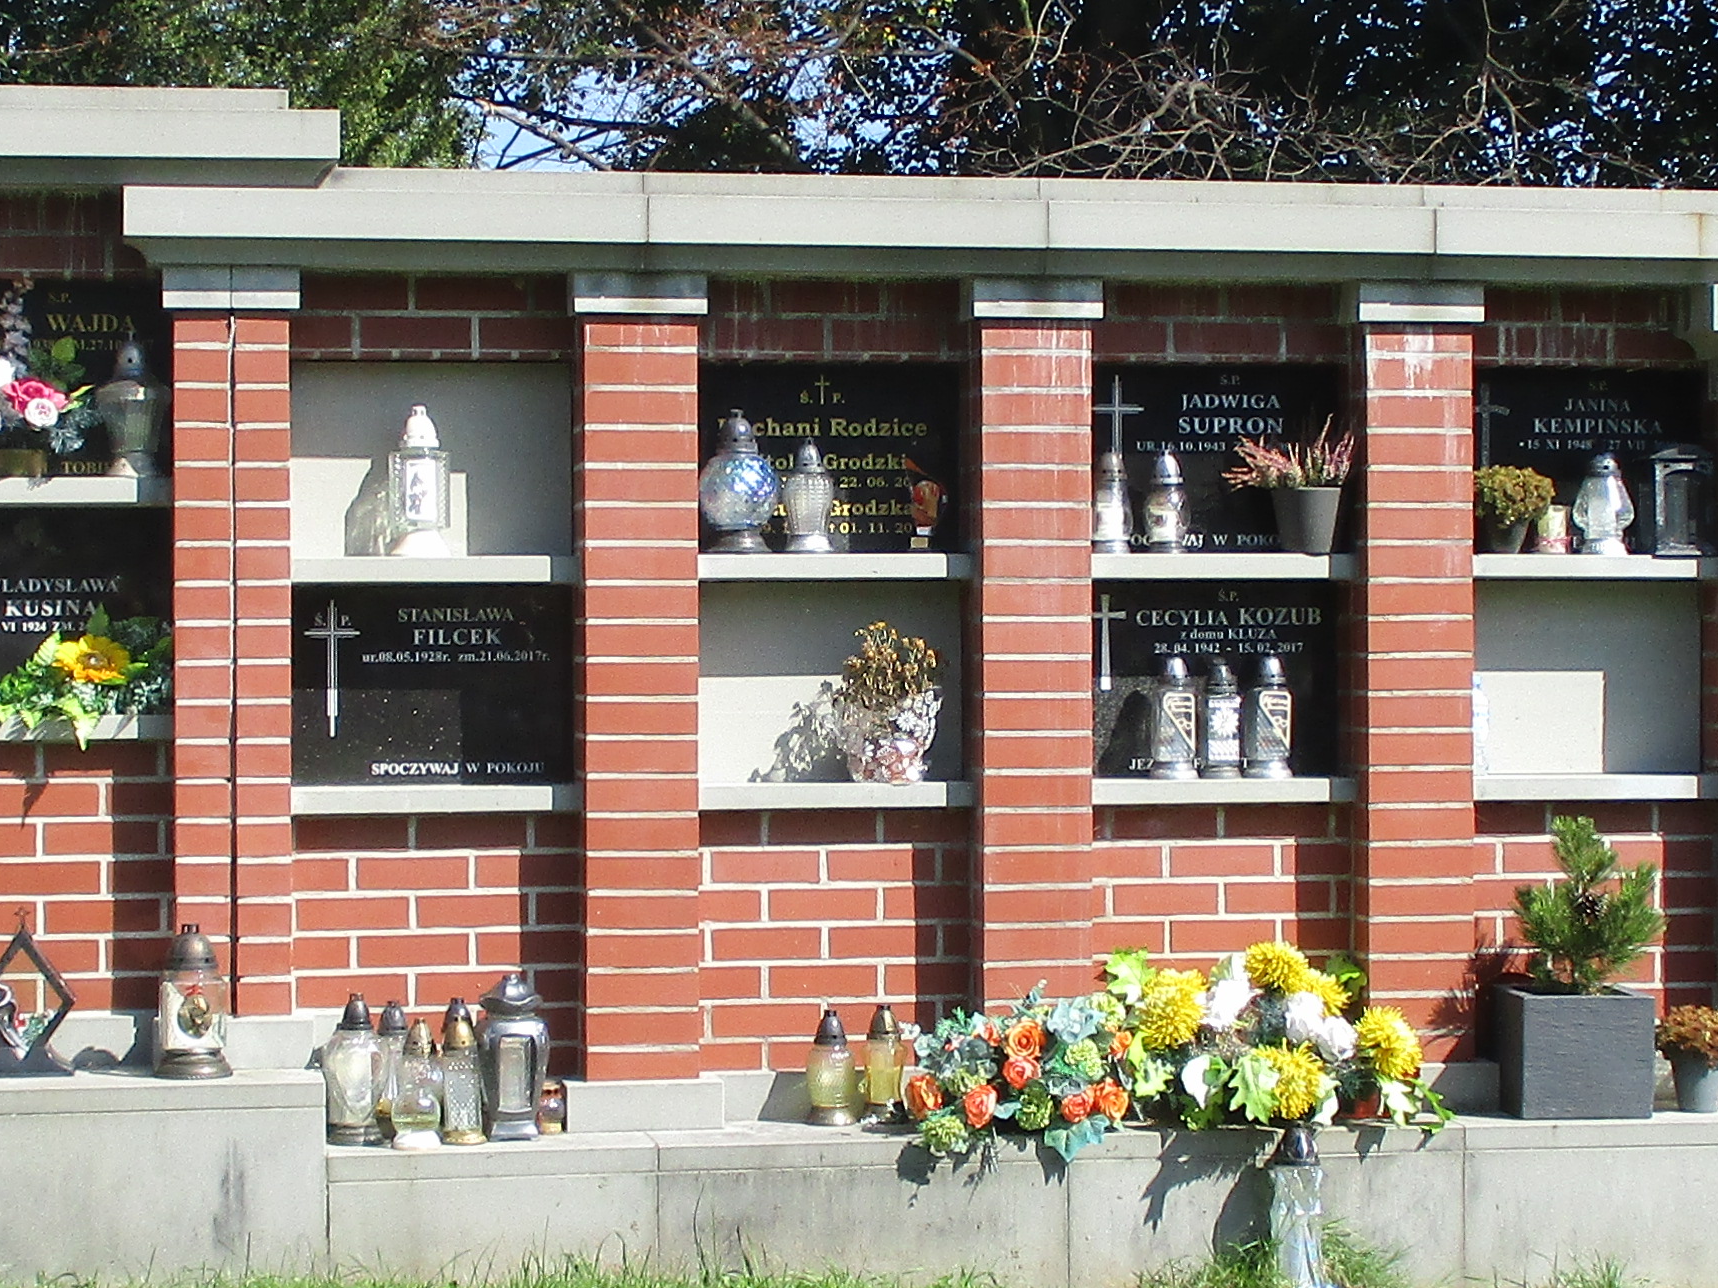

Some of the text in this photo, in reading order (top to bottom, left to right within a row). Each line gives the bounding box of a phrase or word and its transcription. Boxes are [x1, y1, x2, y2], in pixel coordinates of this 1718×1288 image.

[46, 313, 137, 333] WAJDA
[1181, 393, 1281, 411] JADWIGA
[1564, 397, 1631, 413] JANINA
[829, 417, 928, 437] Rodzice
[1177, 416, 1284, 435] SUPRON
[1532, 414, 1663, 434] KEMPIŃSKA
[823, 454, 907, 472] Grodzki
[839, 476, 863, 488] 22.
[893, 475, 912, 488] 20
[1212, 533, 1230, 547] W
[4, 598, 97, 618] KUSINA
[397, 607, 514, 623] STANISŁAWA
[1135, 607, 1323, 626] CECYLIA KOZUB
[21, 621, 47, 633] 1924
[1190, 628, 1224, 640] domu
[412, 628, 502, 646] FILCEK
[1195, 642, 1221, 654] 1942
[1278, 642, 1304, 654] 2017
[371, 760, 546, 776] SPOCZYWAJ W POKOJU
[1128, 758, 1155, 770] JEZ
